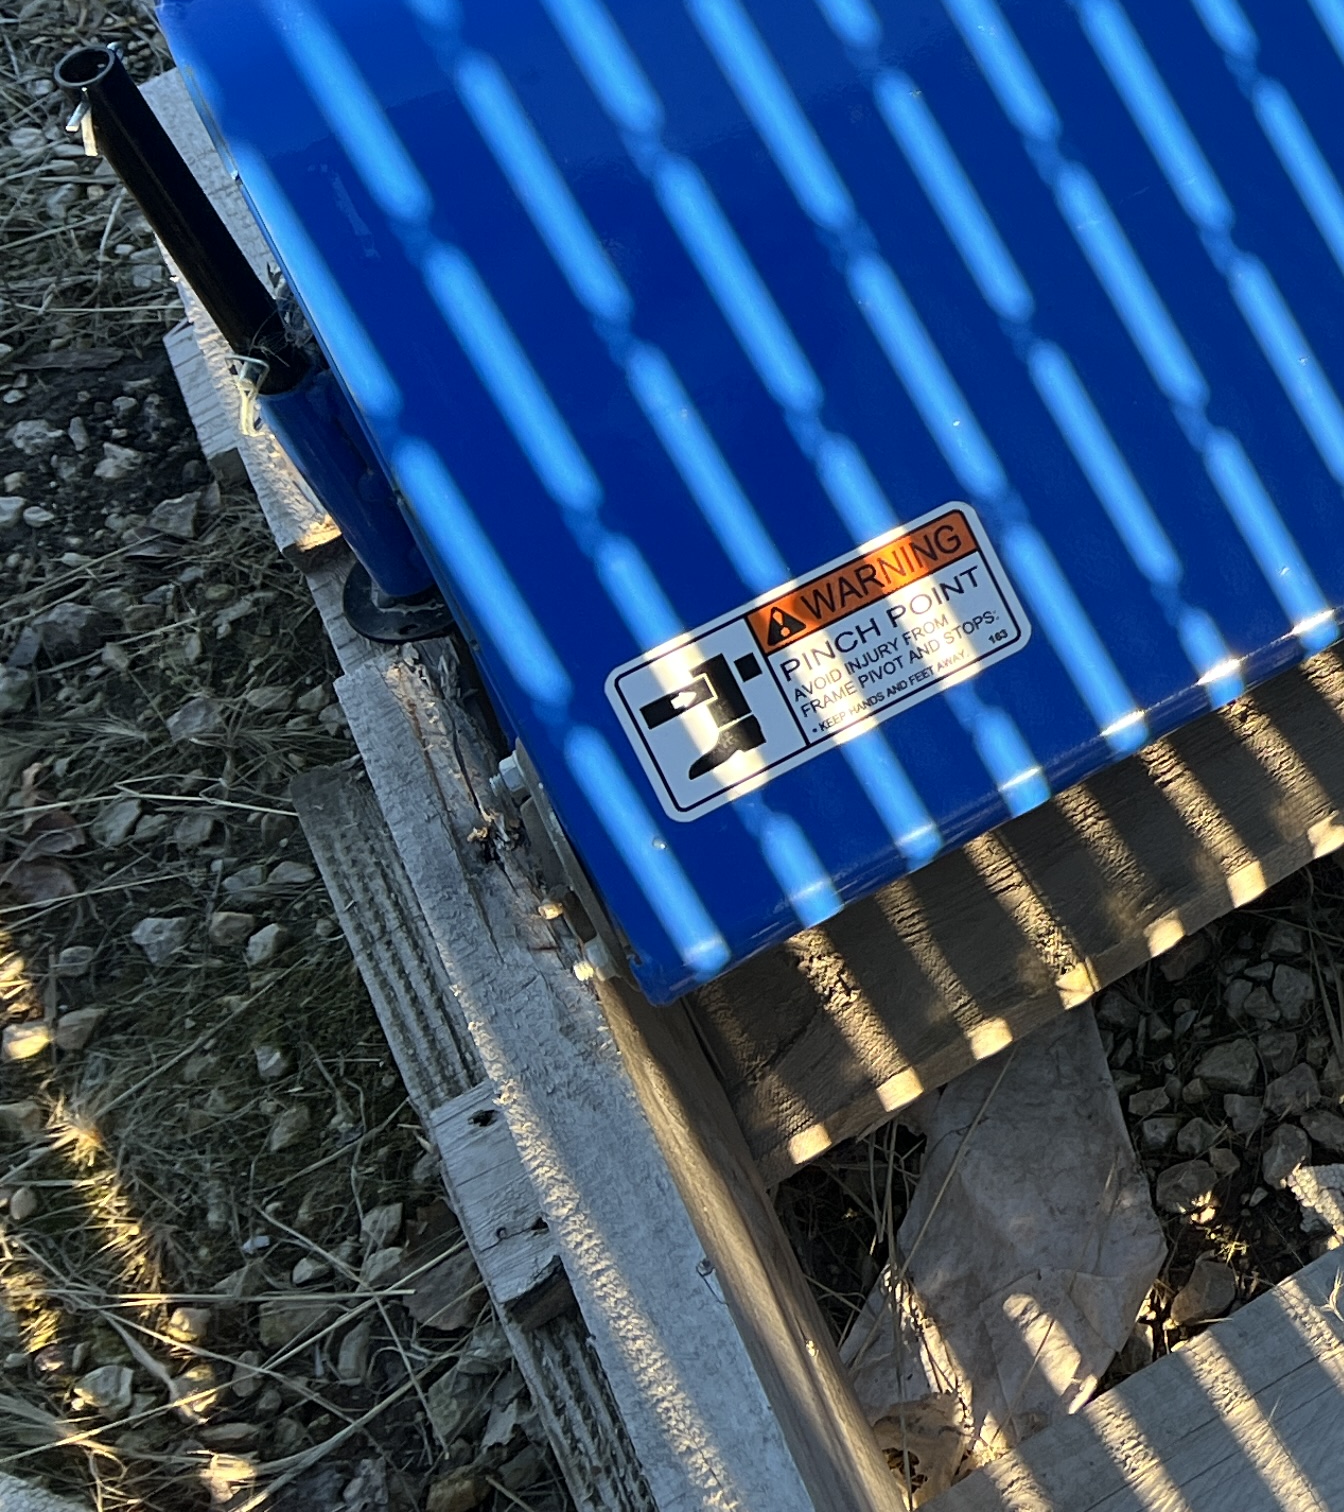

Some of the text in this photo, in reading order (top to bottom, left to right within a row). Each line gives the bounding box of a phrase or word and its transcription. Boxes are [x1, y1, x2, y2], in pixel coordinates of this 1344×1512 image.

[778, 564, 985, 682] PINCH POINT
[800, 520, 963, 623] WARNING
[791, 612, 949, 702] AVOID INJURY FROM
[799, 607, 1000, 718] FRAME PIVOT AND STOPS:
[818, 710, 847, 731] KEEP
[847, 691, 885, 716] HANDS
[885, 679, 908, 697] AND
[908, 665, 935, 685] FEET
